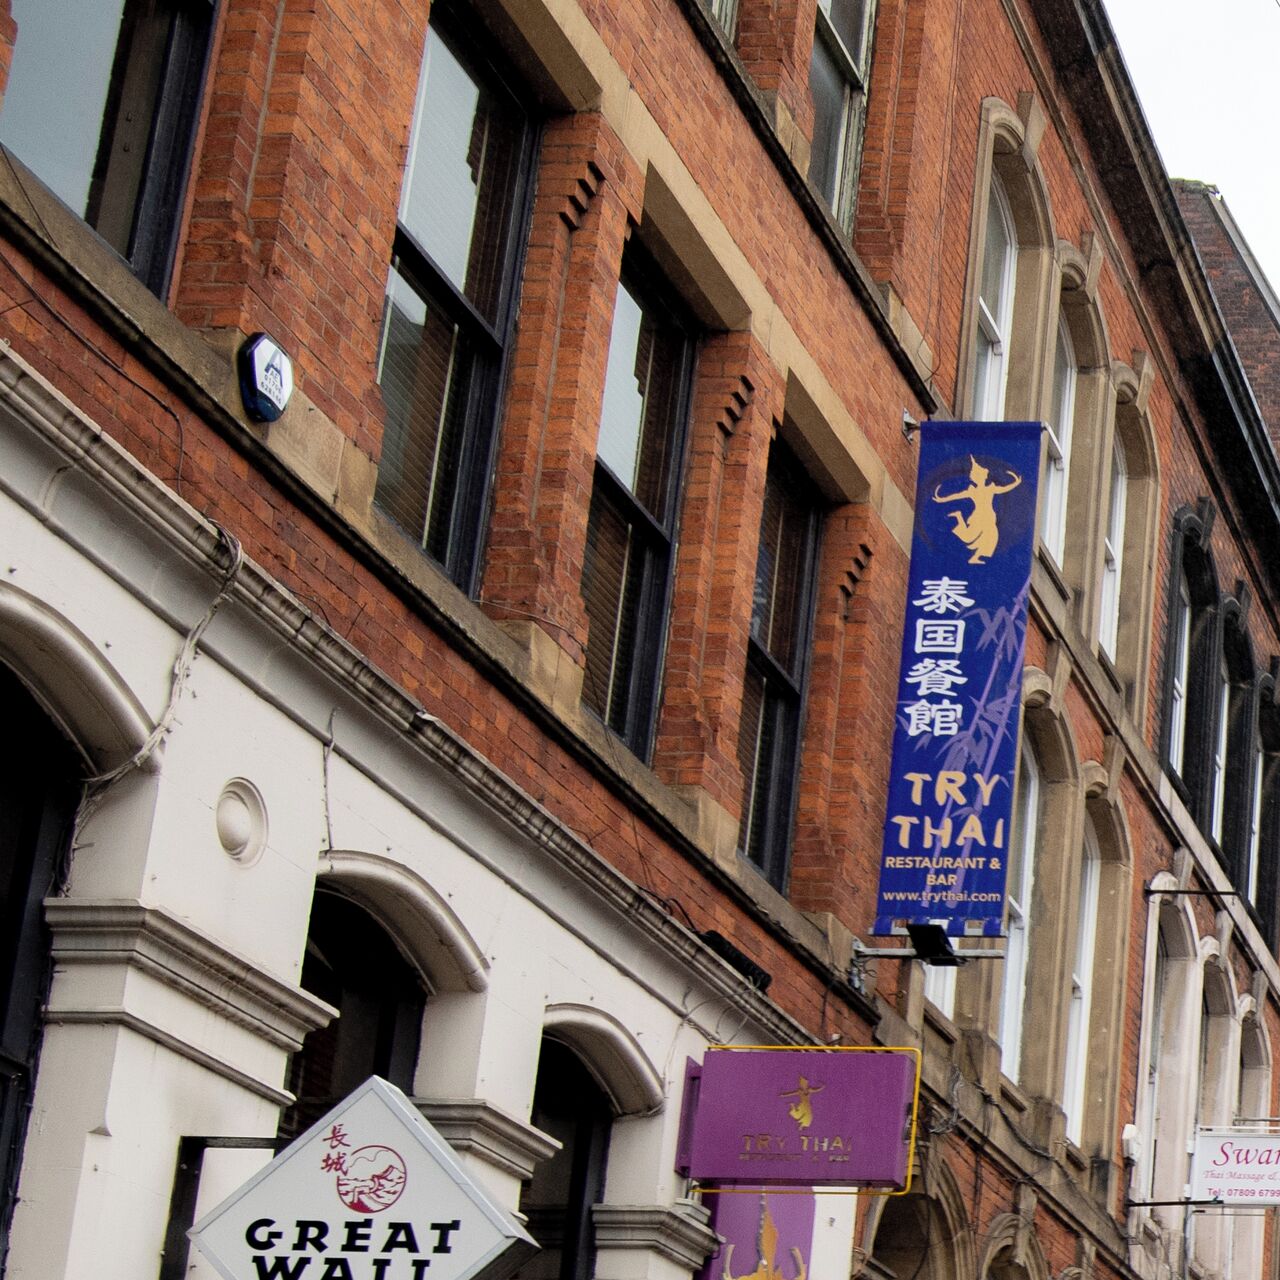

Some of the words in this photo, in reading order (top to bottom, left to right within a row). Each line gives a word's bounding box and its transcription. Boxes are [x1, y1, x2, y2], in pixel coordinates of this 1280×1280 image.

[905, 575, 976, 737] 泰国餐館
[903, 772, 1001, 806] TRY
[891, 815, 1005, 850] THAI
[885, 855, 987, 870] RESTAURANT
[989, 856, 1002, 870] &
[926, 872, 958, 887] BAR
[883, 889, 1003, 904] www.trythai.com
[321, 1124, 351, 1176] 長城
[800, 1135, 853, 1152] THAI
[1226, 1170, 1266, 1183] Massage
[245, 1217, 462, 1254] GREAT
